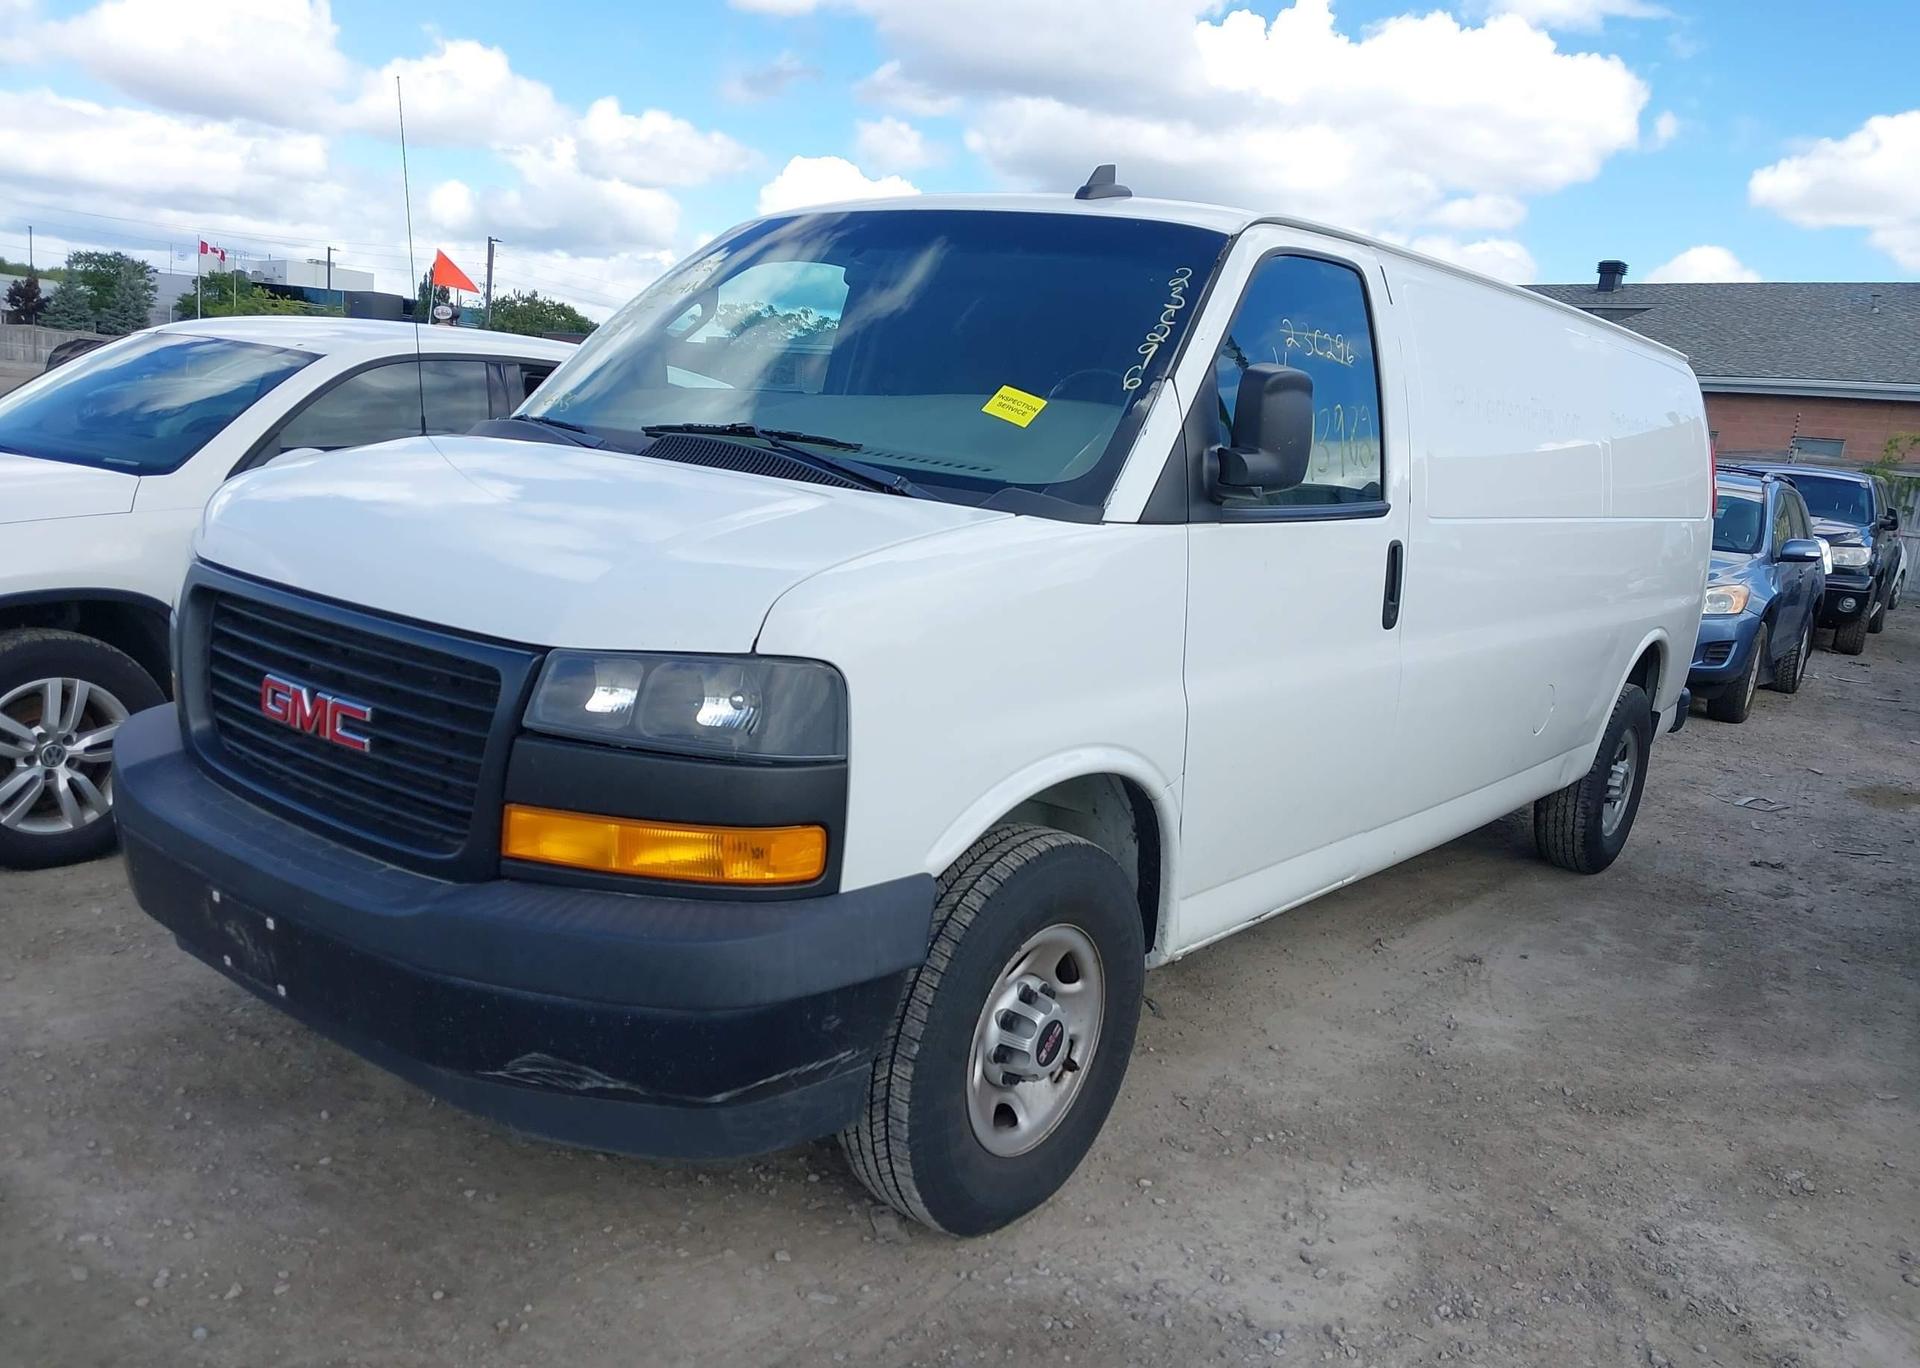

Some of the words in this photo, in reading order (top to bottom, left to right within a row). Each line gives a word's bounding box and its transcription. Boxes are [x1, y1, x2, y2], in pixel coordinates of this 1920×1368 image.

[1282, 318, 1355, 365] 23C296
[996, 401, 1028, 417] SERVICE
[997, 393, 1039, 413] INSPECTION
[260, 673, 372, 753] GMC
